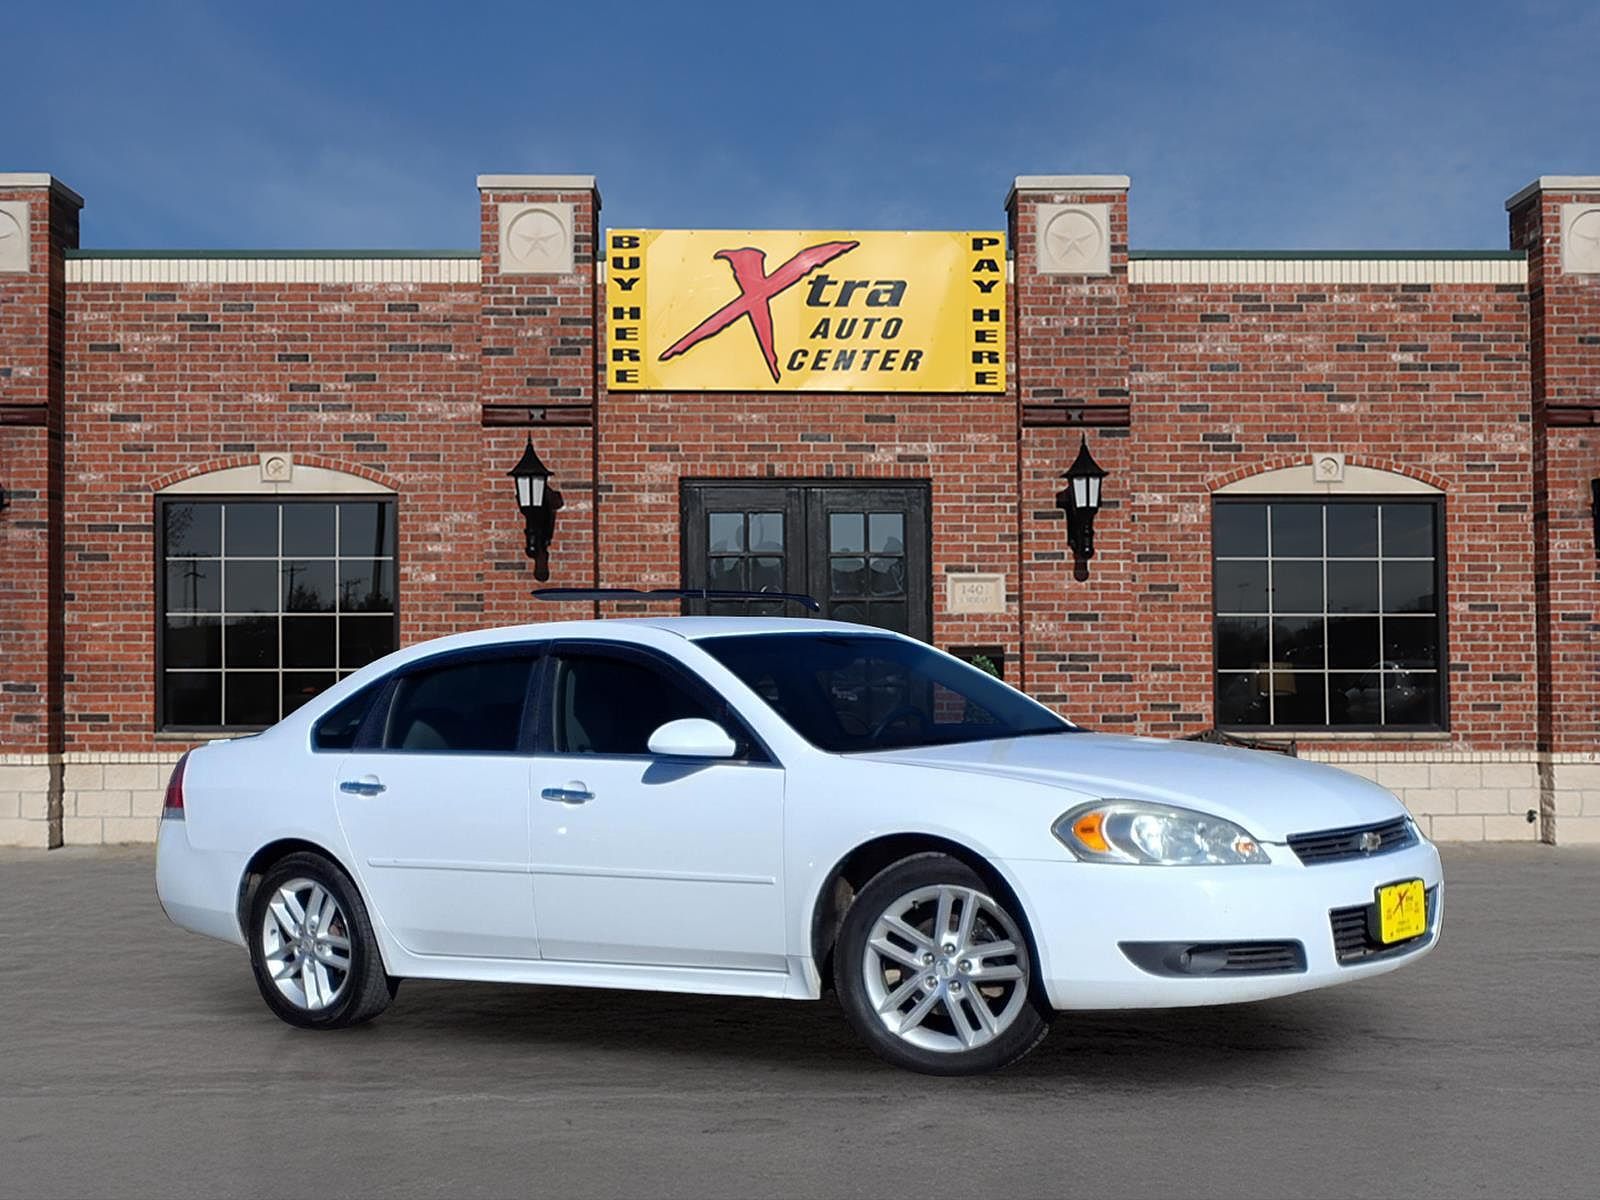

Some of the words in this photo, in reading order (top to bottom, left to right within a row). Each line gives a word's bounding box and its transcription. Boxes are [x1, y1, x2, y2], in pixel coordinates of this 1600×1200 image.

[611, 235, 641, 292] BUY
[971, 237, 1001, 294] PAY
[611, 306, 641, 384] HERE
[809, 317, 904, 340] AUTO
[971, 308, 1001, 386] HERE
[786, 348, 924, 372] CENTER
